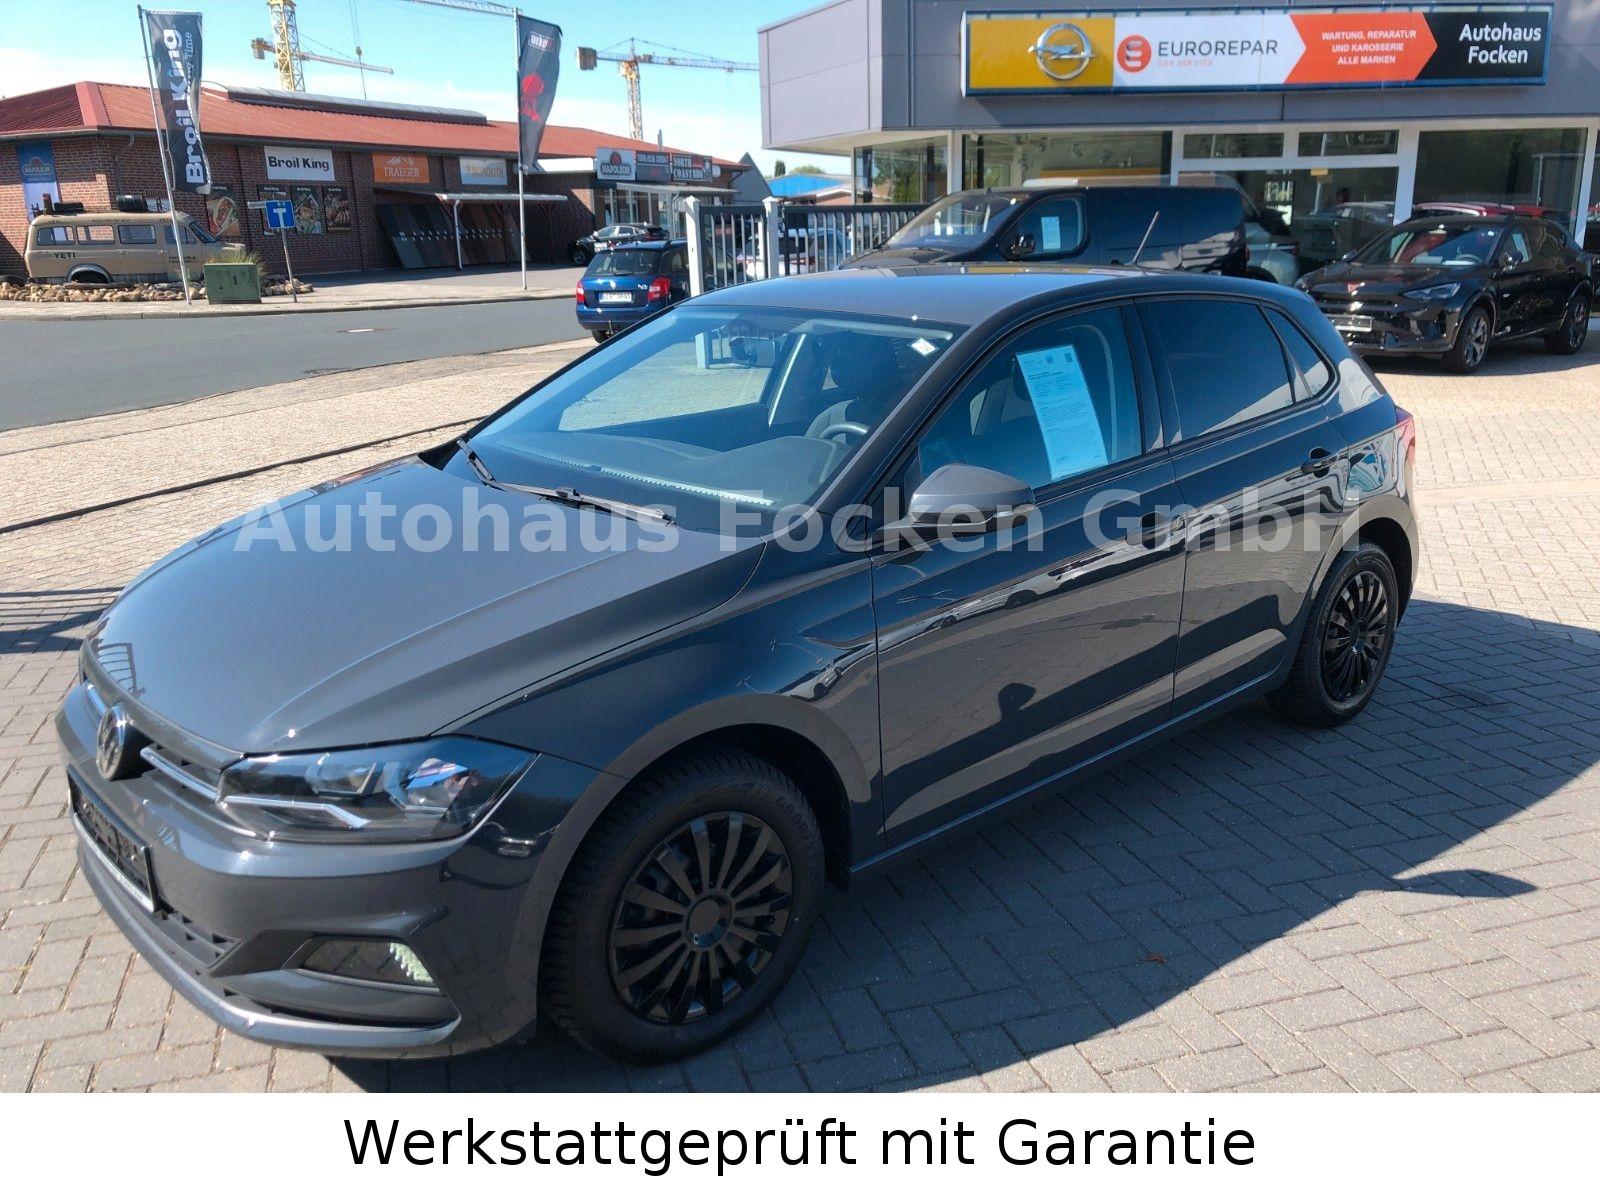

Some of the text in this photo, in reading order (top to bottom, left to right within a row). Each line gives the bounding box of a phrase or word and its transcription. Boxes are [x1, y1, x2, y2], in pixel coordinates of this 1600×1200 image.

[1322, 29, 1417, 41] WARTUNG, REPARATUR
[1459, 22, 1542, 41] Autohaus
[1158, 39, 1278, 57] EUROREPAR
[1331, 42, 1405, 52] UND KAROSSERIE
[1337, 55, 1396, 65] ALLE MARKEN
[1467, 45, 1529, 64] Focken
[163, 28, 204, 184] Broil King
[268, 156, 330, 171] Broil King
[384, 166, 420, 177] TRAEGER
[53, 251, 76, 259] YETI
